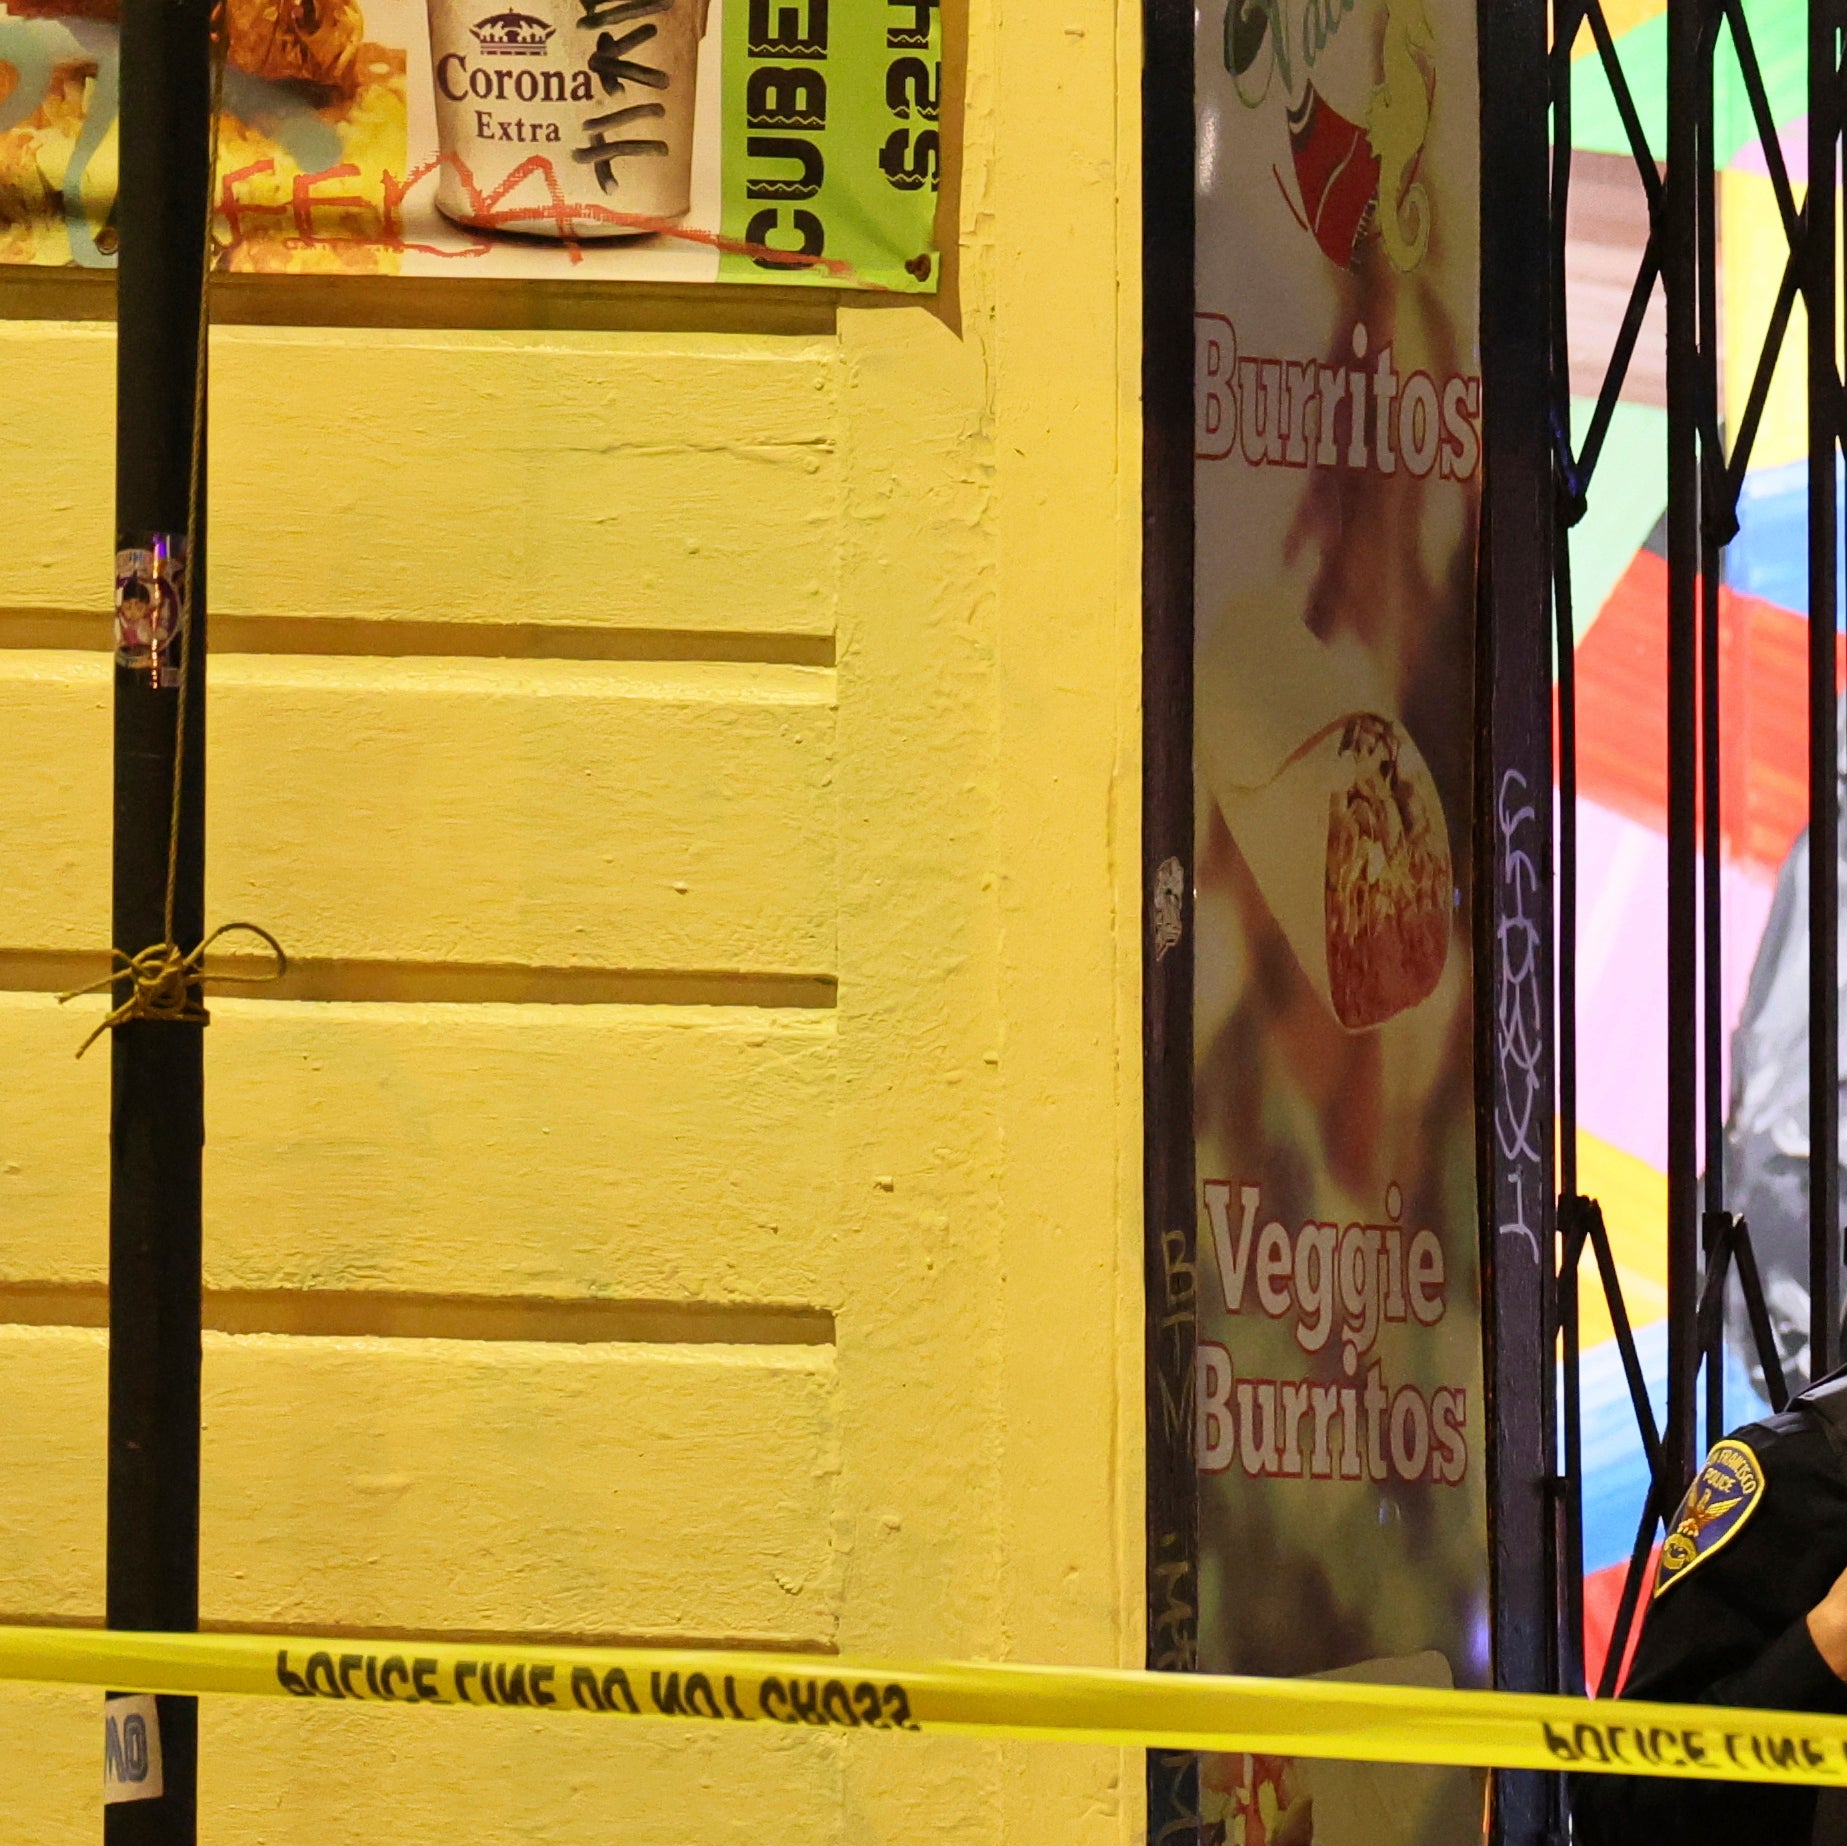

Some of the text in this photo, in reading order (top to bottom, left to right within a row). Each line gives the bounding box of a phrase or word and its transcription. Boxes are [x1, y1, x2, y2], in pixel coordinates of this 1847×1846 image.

[436, 52, 595, 102] Corona
[475, 109, 561, 143] Extra
[1195, 312, 1479, 479] Burritos
[1203, 1180, 1447, 1353] Veggie
[1197, 1338, 1467, 1484] Burritos
